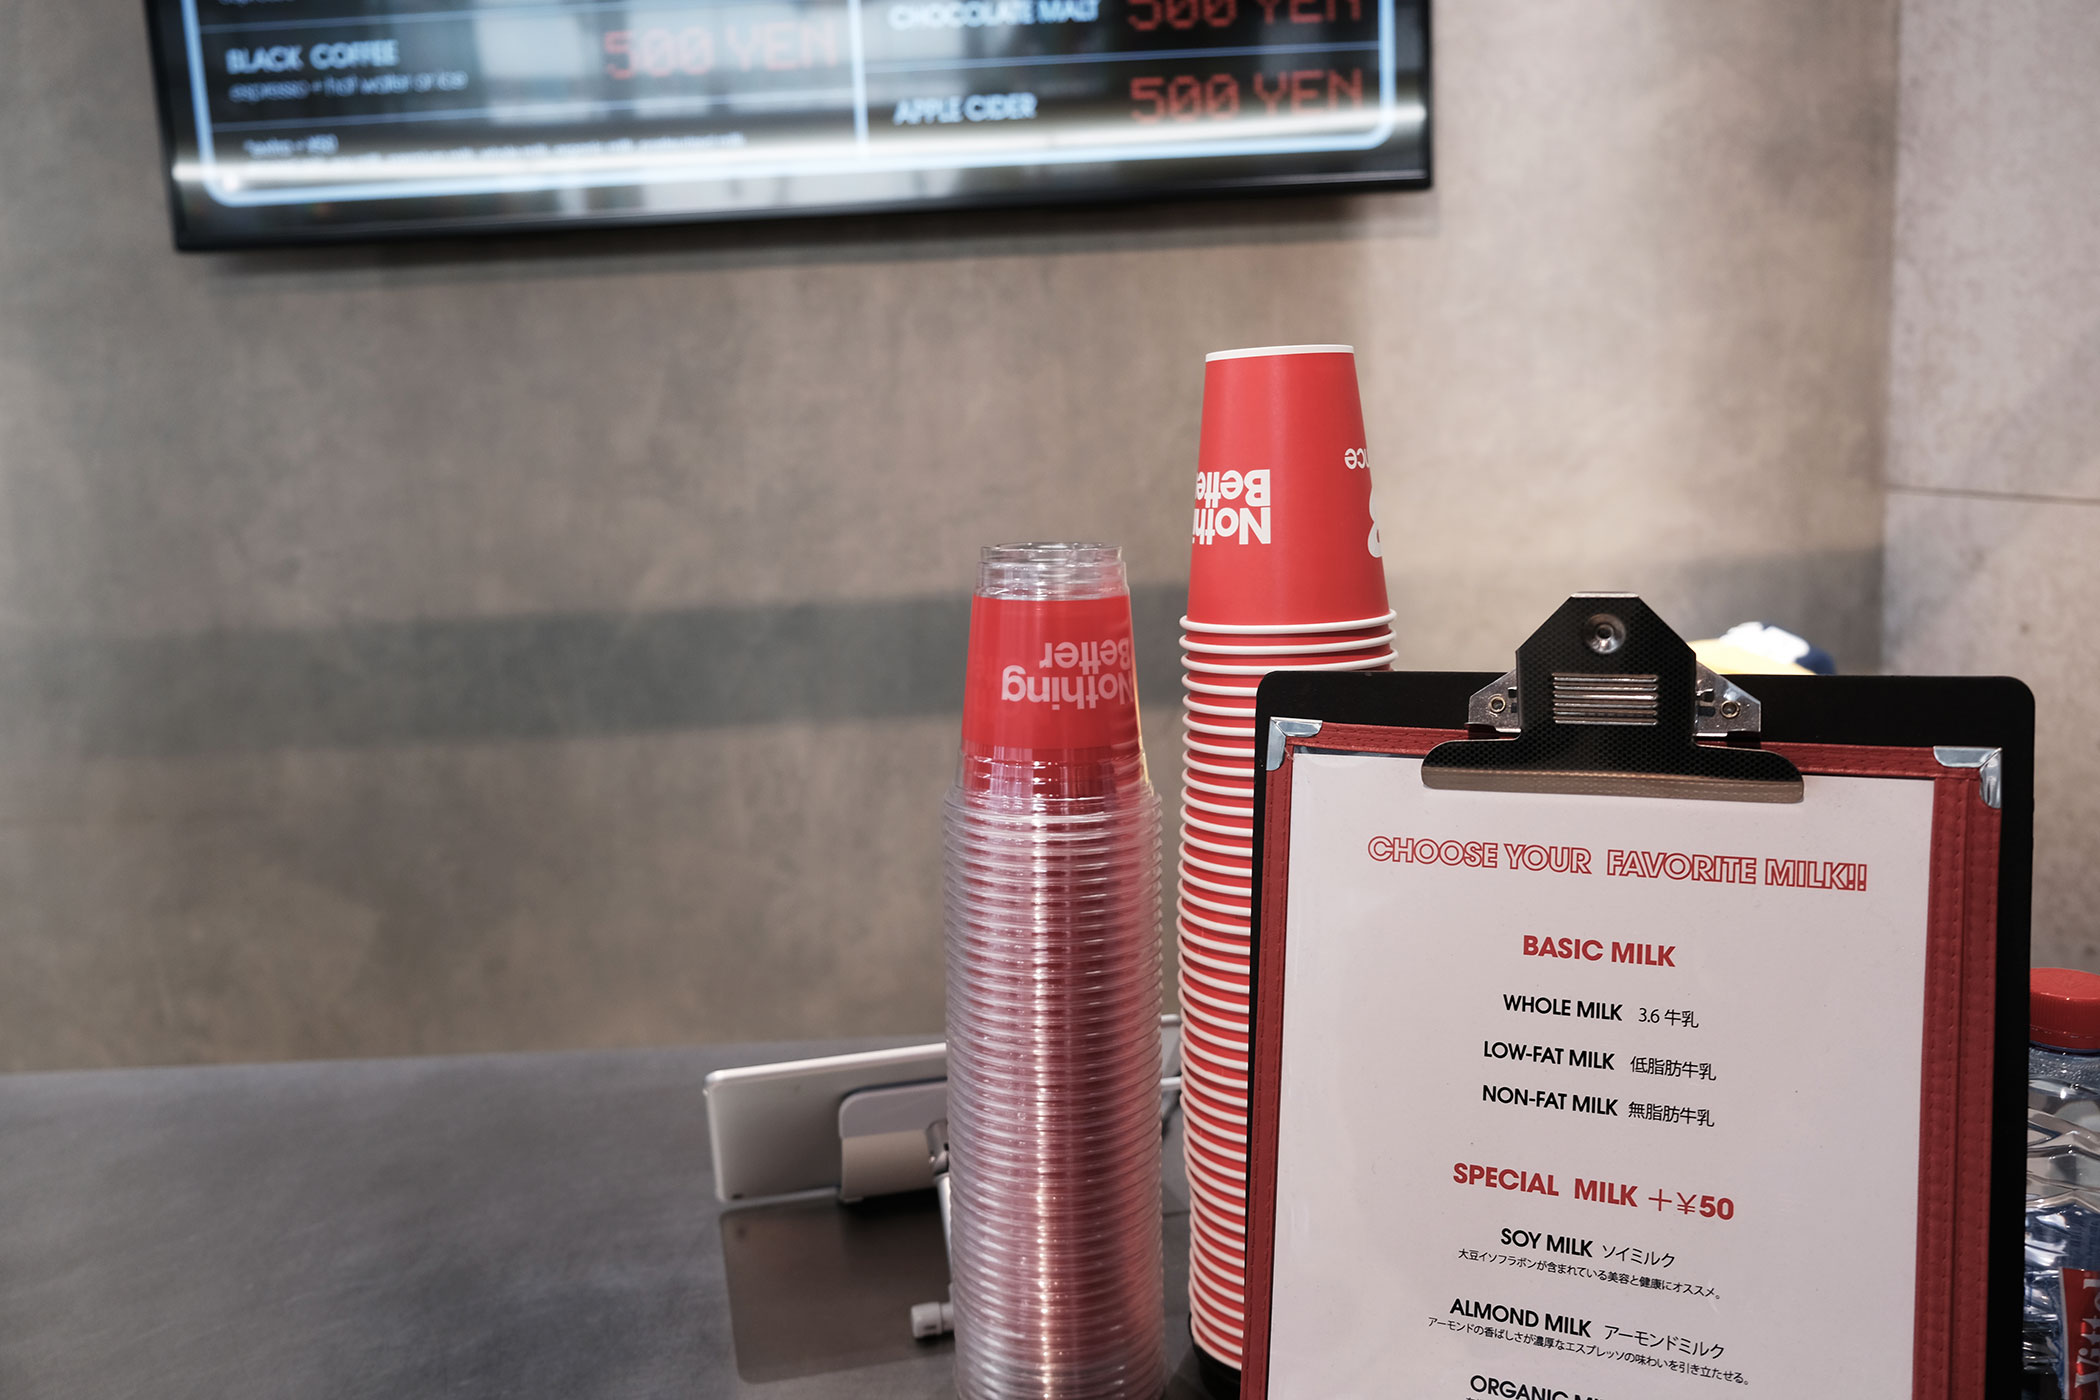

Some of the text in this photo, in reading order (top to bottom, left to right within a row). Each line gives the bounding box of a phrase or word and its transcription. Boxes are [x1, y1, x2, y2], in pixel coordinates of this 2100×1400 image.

[225, 39, 399, 74] BLACK COFFEE
[605, 19, 838, 79] 500 YEN
[893, 92, 1038, 125] APPLE CIDER
[1130, 69, 1363, 124] 500 YEN
[1039, 638, 1132, 675] Better
[1001, 665, 1135, 710] Nothing
[1368, 836, 1867, 891] CHOOSE YOUR FAVORITE MILK!!
[1522, 935, 1676, 967] BASIC MILK
[1503, 994, 1699, 1029] WHOLE MILK 3.6 牛乳
[1484, 1041, 1717, 1081] LOW-FAT MILK 低脂肪牛乳
[1482, 1085, 1715, 1128] NON-FAT MILK 無脂肪牛乳
[1453, 1162, 1559, 1197] SPECIAL
[1574, 1178, 1638, 1207] MILK
[1500, 1227, 1675, 1268] SOY MILK ソイミルク
[1450, 1298, 1725, 1359] ALMOND MILK アーモンドミルク
